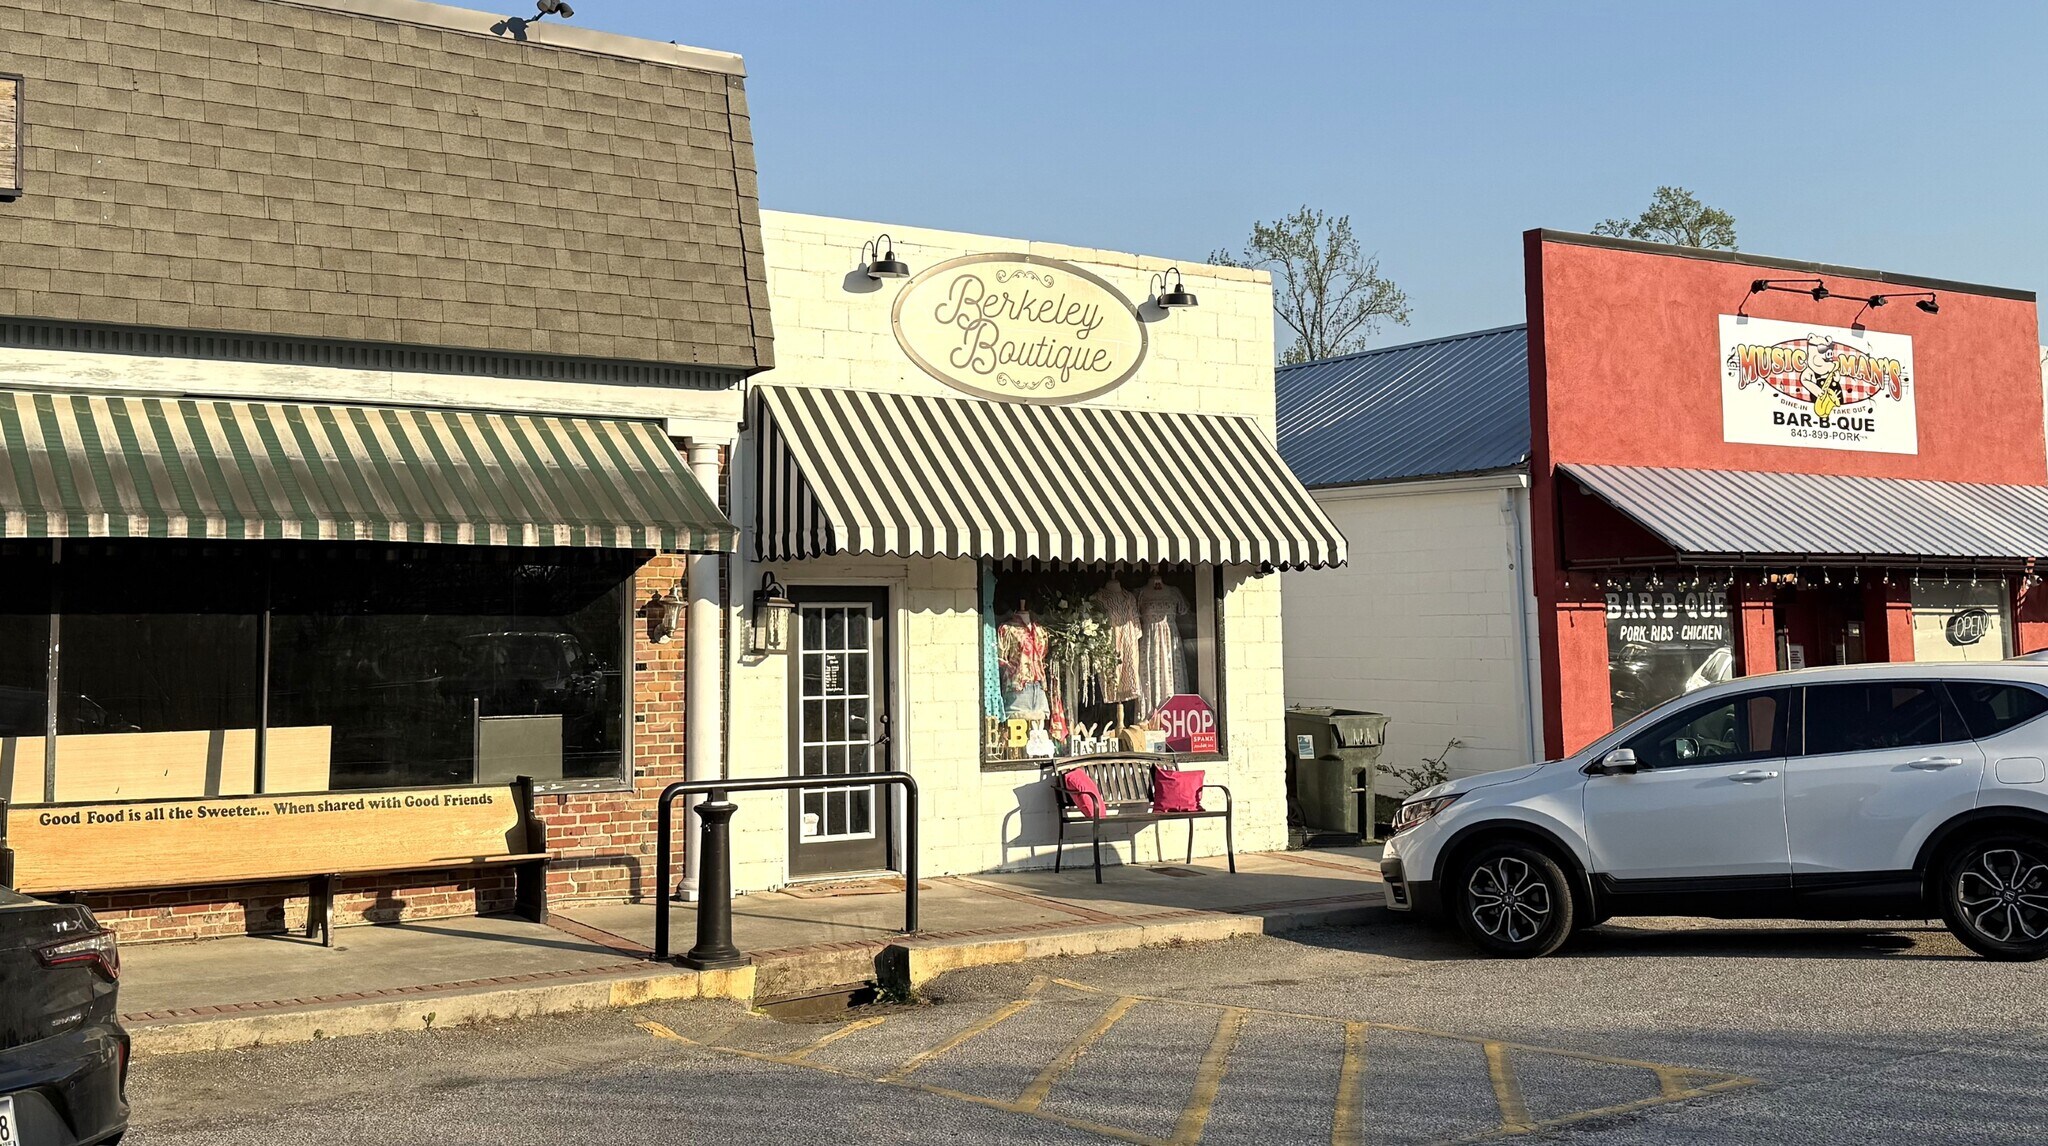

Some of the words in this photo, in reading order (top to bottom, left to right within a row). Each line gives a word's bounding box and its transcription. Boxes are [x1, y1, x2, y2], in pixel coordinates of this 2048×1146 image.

[935, 273, 1104, 340] Berkeley
[950, 318, 1112, 383] Boutique
[1736, 343, 1809, 390] MUSIC
[1838, 353, 1902, 401] MAN'S
[1773, 411, 1875, 432] BAR-B-QUE
[1790, 428, 1861, 441] 843-899-PORK
[1605, 592, 1728, 620] BAR-B-QUE
[1619, 625, 1646, 641] PORK
[1651, 625, 1674, 641] RIBS
[1681, 624, 1722, 641] CHICKEN
[1955, 615, 1986, 638] OPEN
[1160, 709, 1214, 738] SHOP
[39, 811, 81, 826] Good
[86, 808, 124, 825] Food
[128, 808, 141, 822] is
[145, 808, 165, 821] all
[168, 806, 194, 820] the
[197, 804, 270, 819] Sweeter...
[273, 802, 315, 815] When
[317, 799, 365, 812] shared
[368, 796, 401, 810] with
[404, 794, 439, 808] Good
[443, 793, 493, 807] Friends
